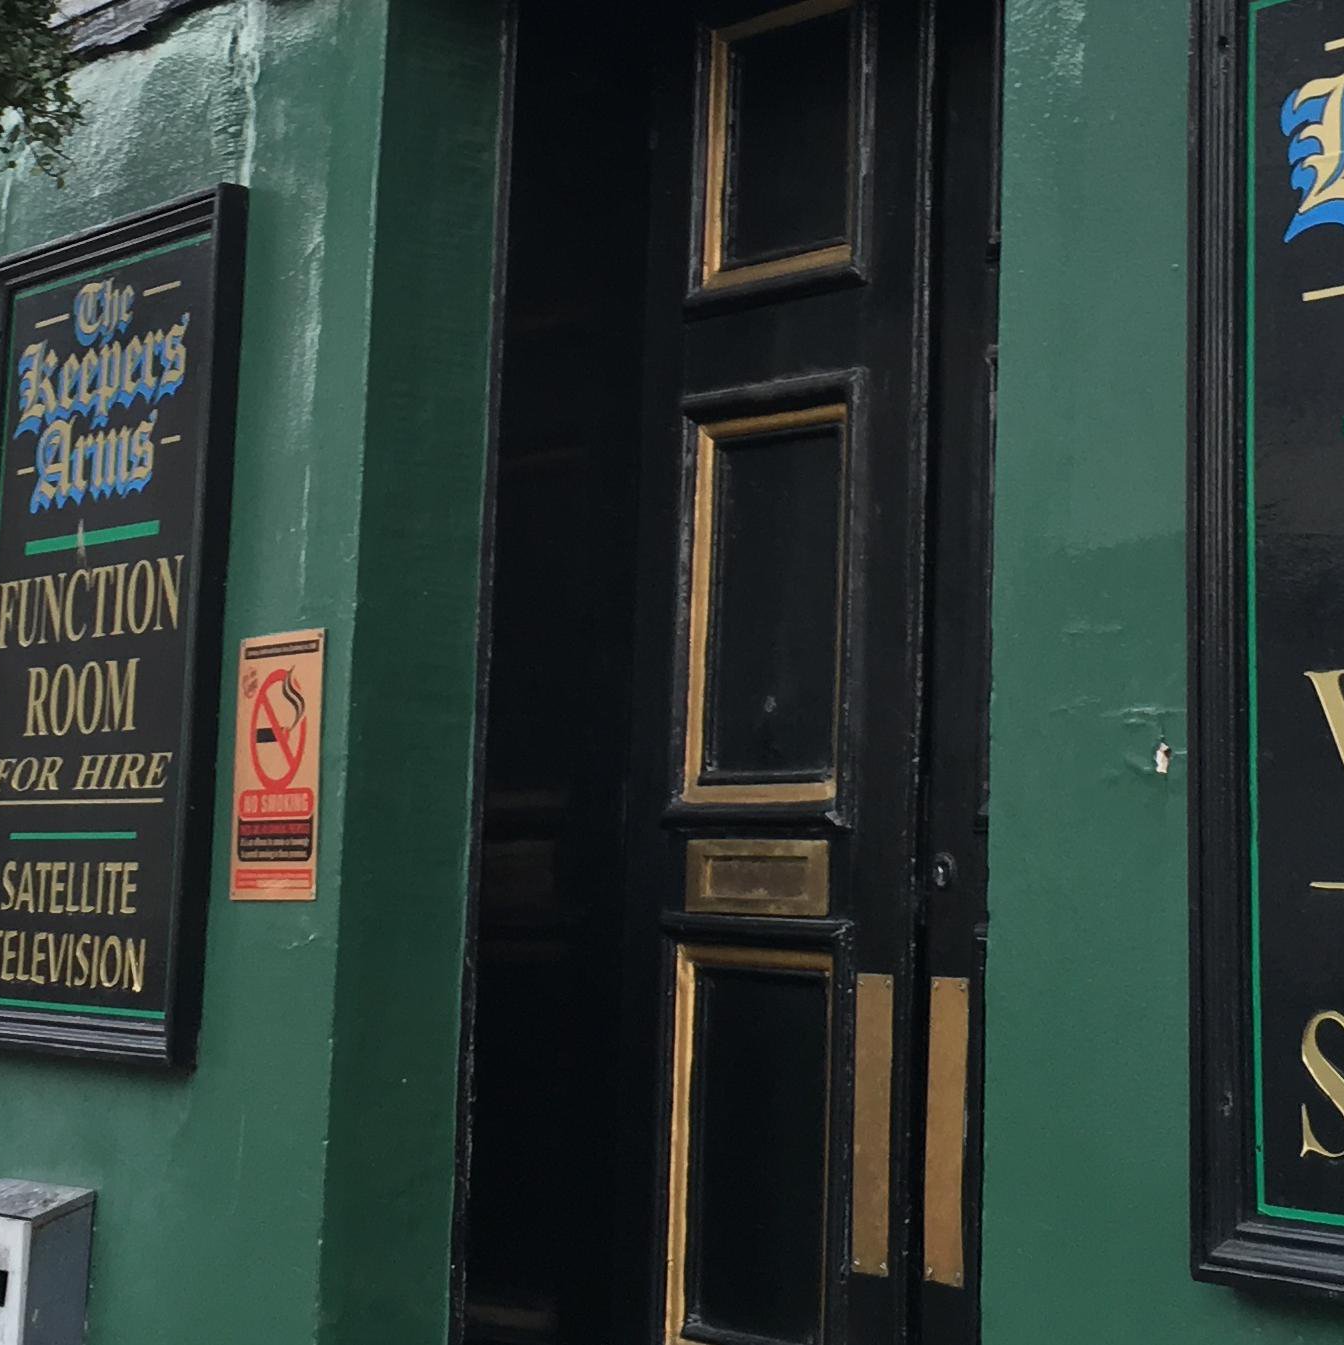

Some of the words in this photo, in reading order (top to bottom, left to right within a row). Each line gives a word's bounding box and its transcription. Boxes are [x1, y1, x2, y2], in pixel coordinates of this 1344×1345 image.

[74, 276, 135, 346] The
[14, 312, 190, 440] Keepers
[30, 408, 158, 514] Arms
[22, 657, 141, 737] ROOM
[72, 752, 173, 791] HIRE
[260, 792, 309, 813] SMOKING
[0, 860, 139, 916] SATELLITE
